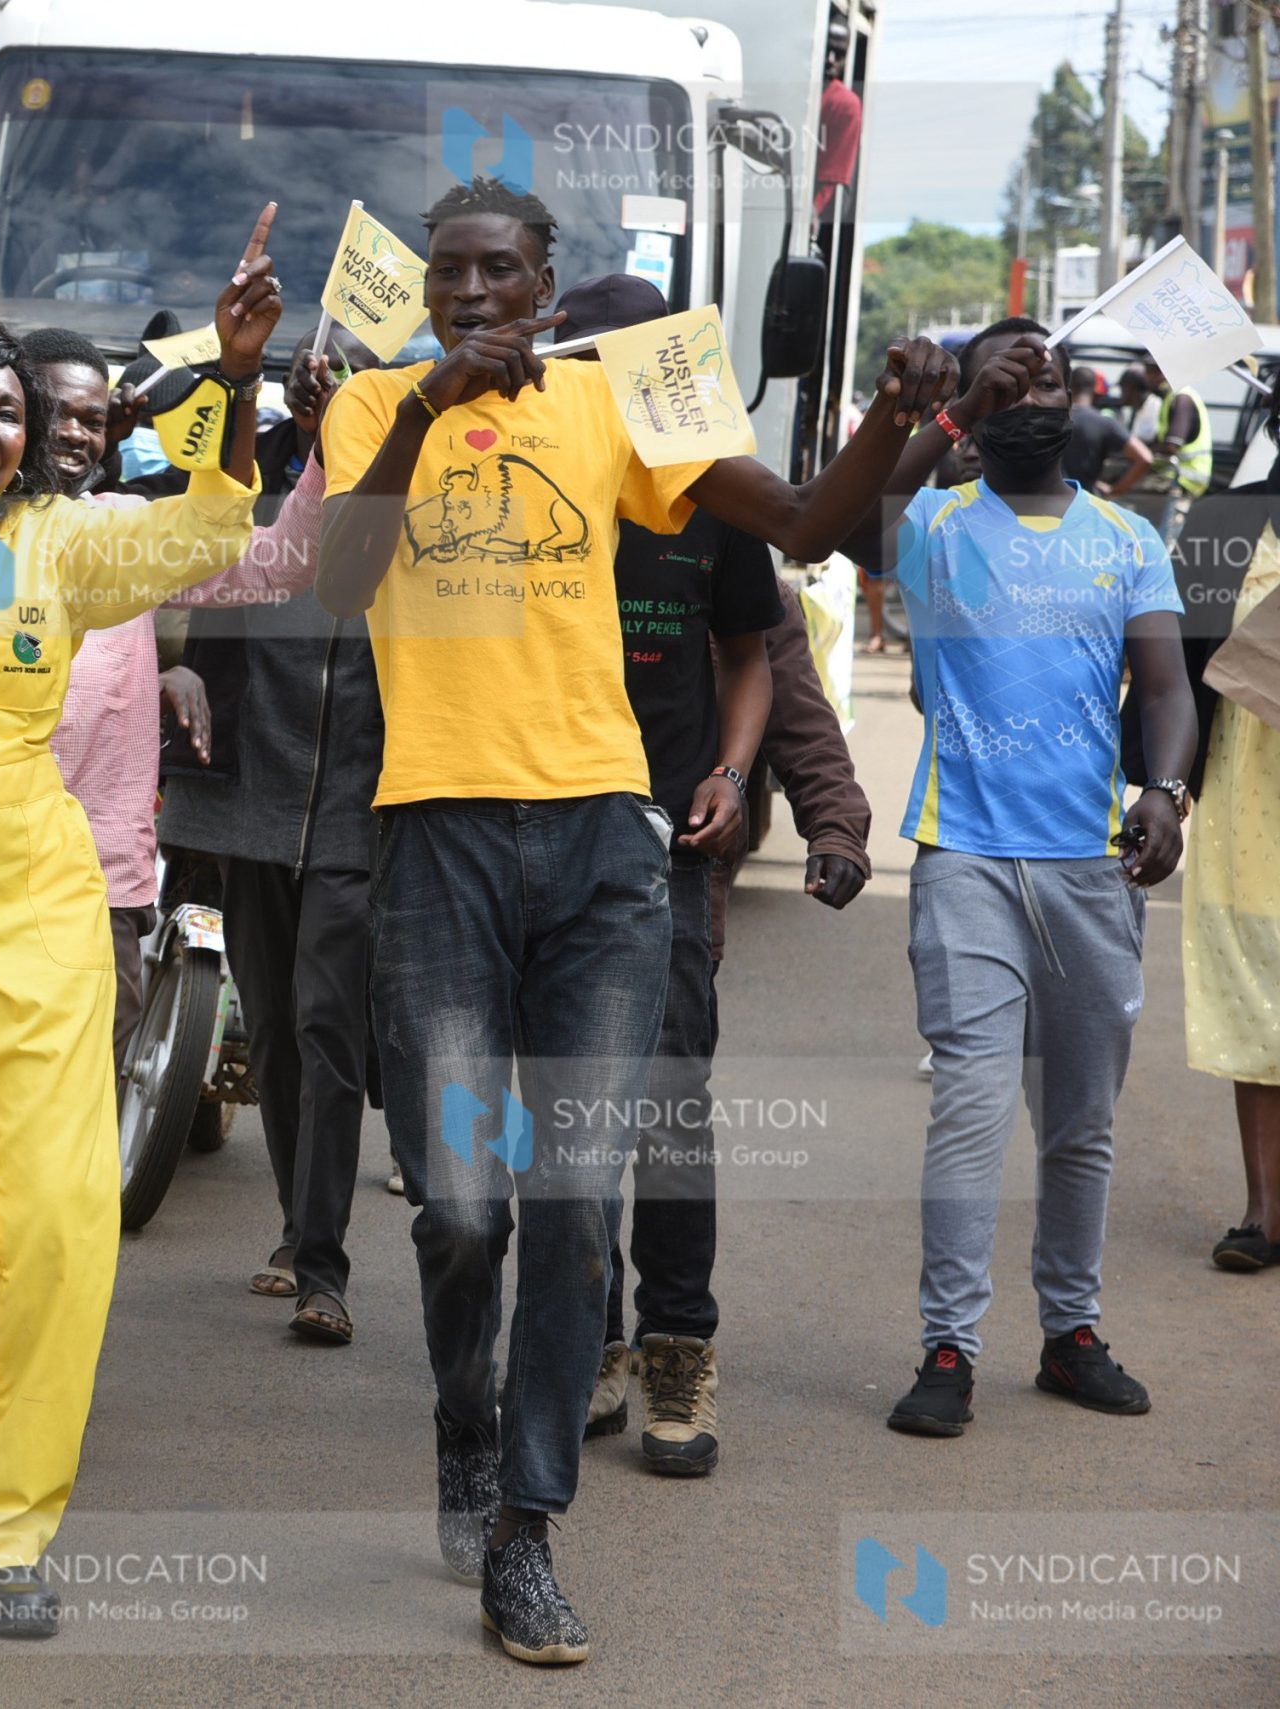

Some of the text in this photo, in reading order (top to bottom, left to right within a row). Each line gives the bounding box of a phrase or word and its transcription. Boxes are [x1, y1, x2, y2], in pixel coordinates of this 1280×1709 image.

[342, 260, 396, 309] NATION
[343, 245, 411, 305] HUSTLER
[352, 297, 379, 321] WOMEN
[656, 348, 691, 428] NATION
[667, 334, 709, 434] HUSTLER
[180, 405, 214, 457] UDA
[449, 434, 453, 450] I
[436, 577, 585, 602] But I stay WOKE!
[19, 606, 46, 624] UDA
[618, 600, 654, 614] ONE
[657, 601, 685, 615] SASA
[647, 621, 682, 635] PEKEE
